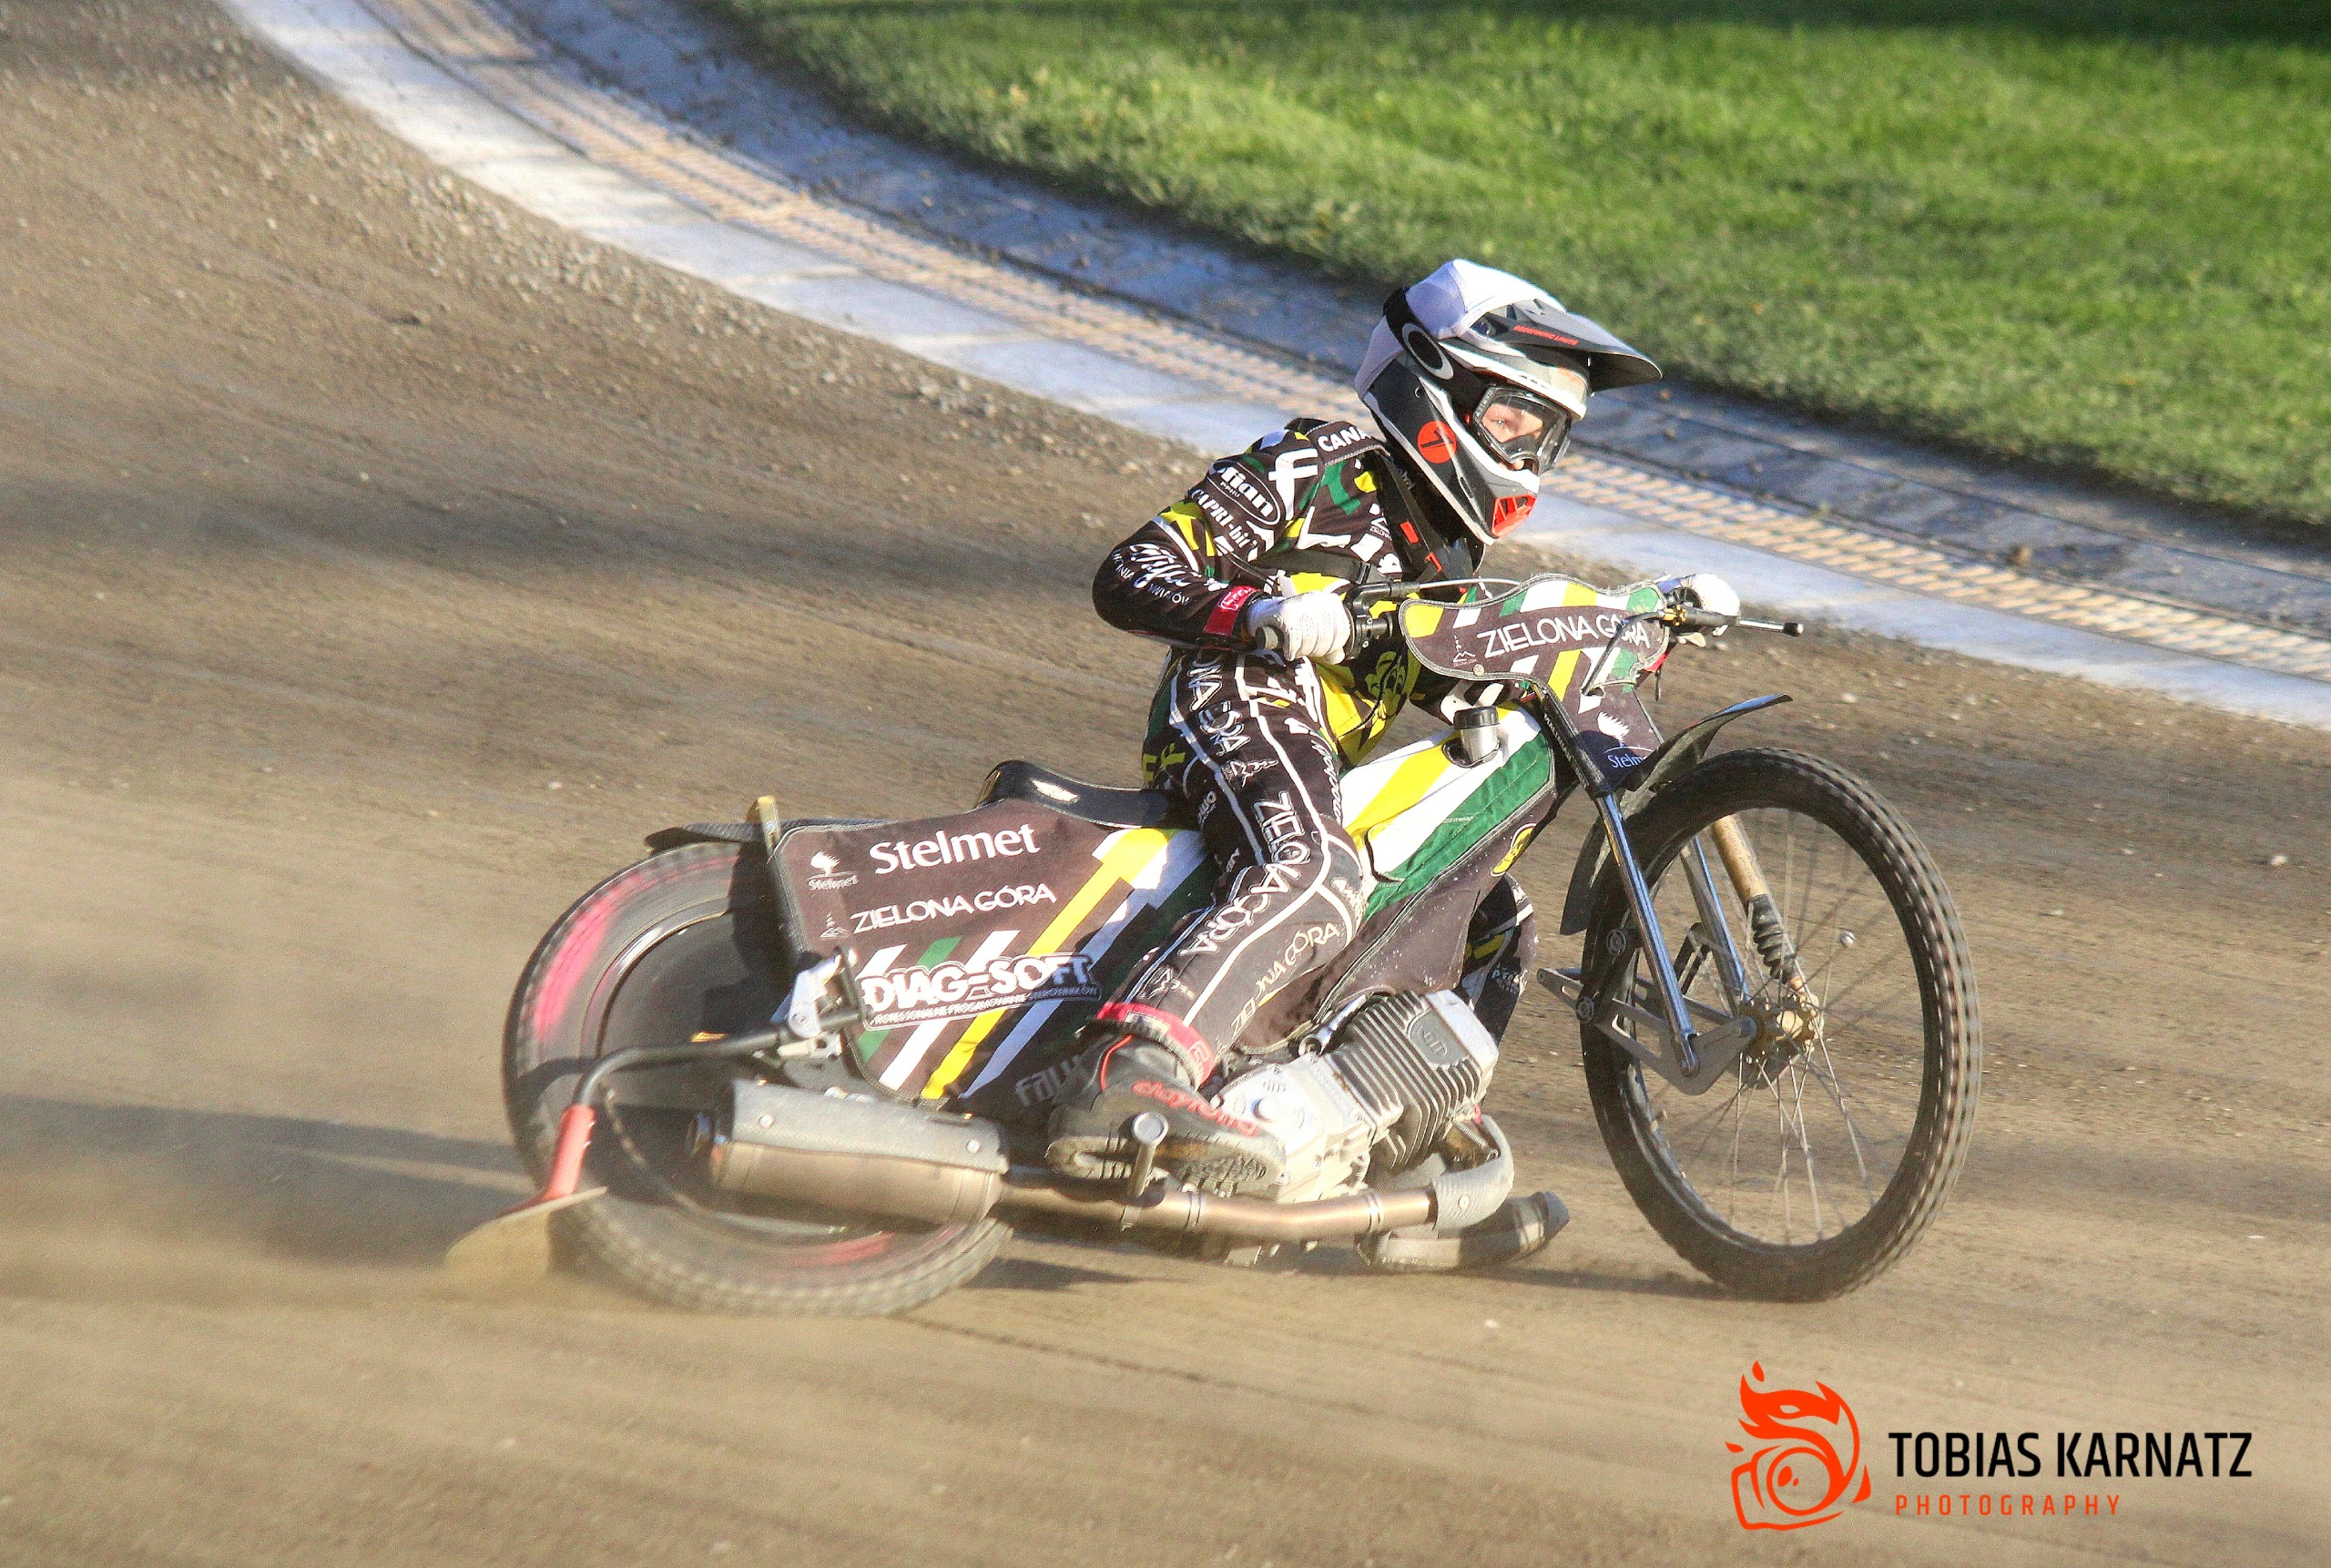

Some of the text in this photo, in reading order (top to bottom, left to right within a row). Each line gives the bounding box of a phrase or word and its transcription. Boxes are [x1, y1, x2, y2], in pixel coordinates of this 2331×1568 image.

[1476, 615, 1599, 658] ZIELONA
[869, 824, 1040, 875] Stelmet
[808, 874, 860, 891] Stelmet
[850, 883, 1057, 934] ZIELONA GÓRA
[860, 955, 1093, 1013] DIAG-SOFT
